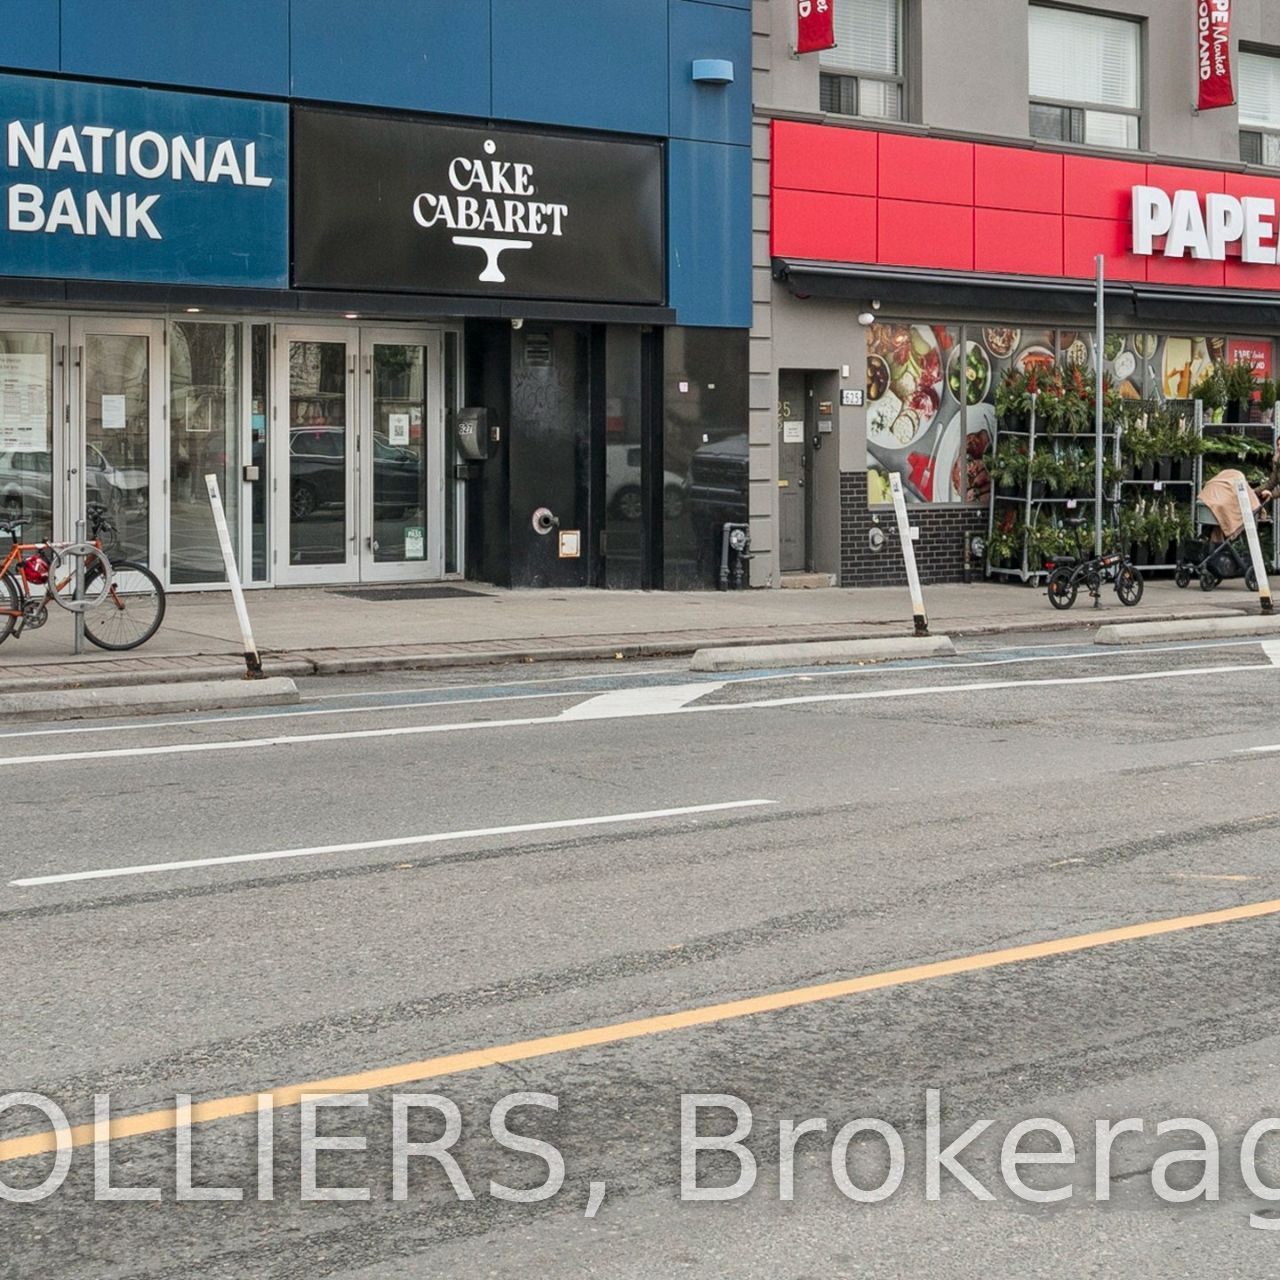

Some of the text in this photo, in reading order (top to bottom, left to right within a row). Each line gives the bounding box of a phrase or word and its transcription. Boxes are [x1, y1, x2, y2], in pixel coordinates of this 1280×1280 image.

[1212, 26, 1228, 76] Market
[7, 120, 273, 188] NATIONAL
[448, 156, 535, 196] CAKE
[7, 184, 162, 240] BANK
[412, 193, 568, 237] CABARET
[1132, 185, 1276, 265] PAPE
[777, 401, 791, 417] 25
